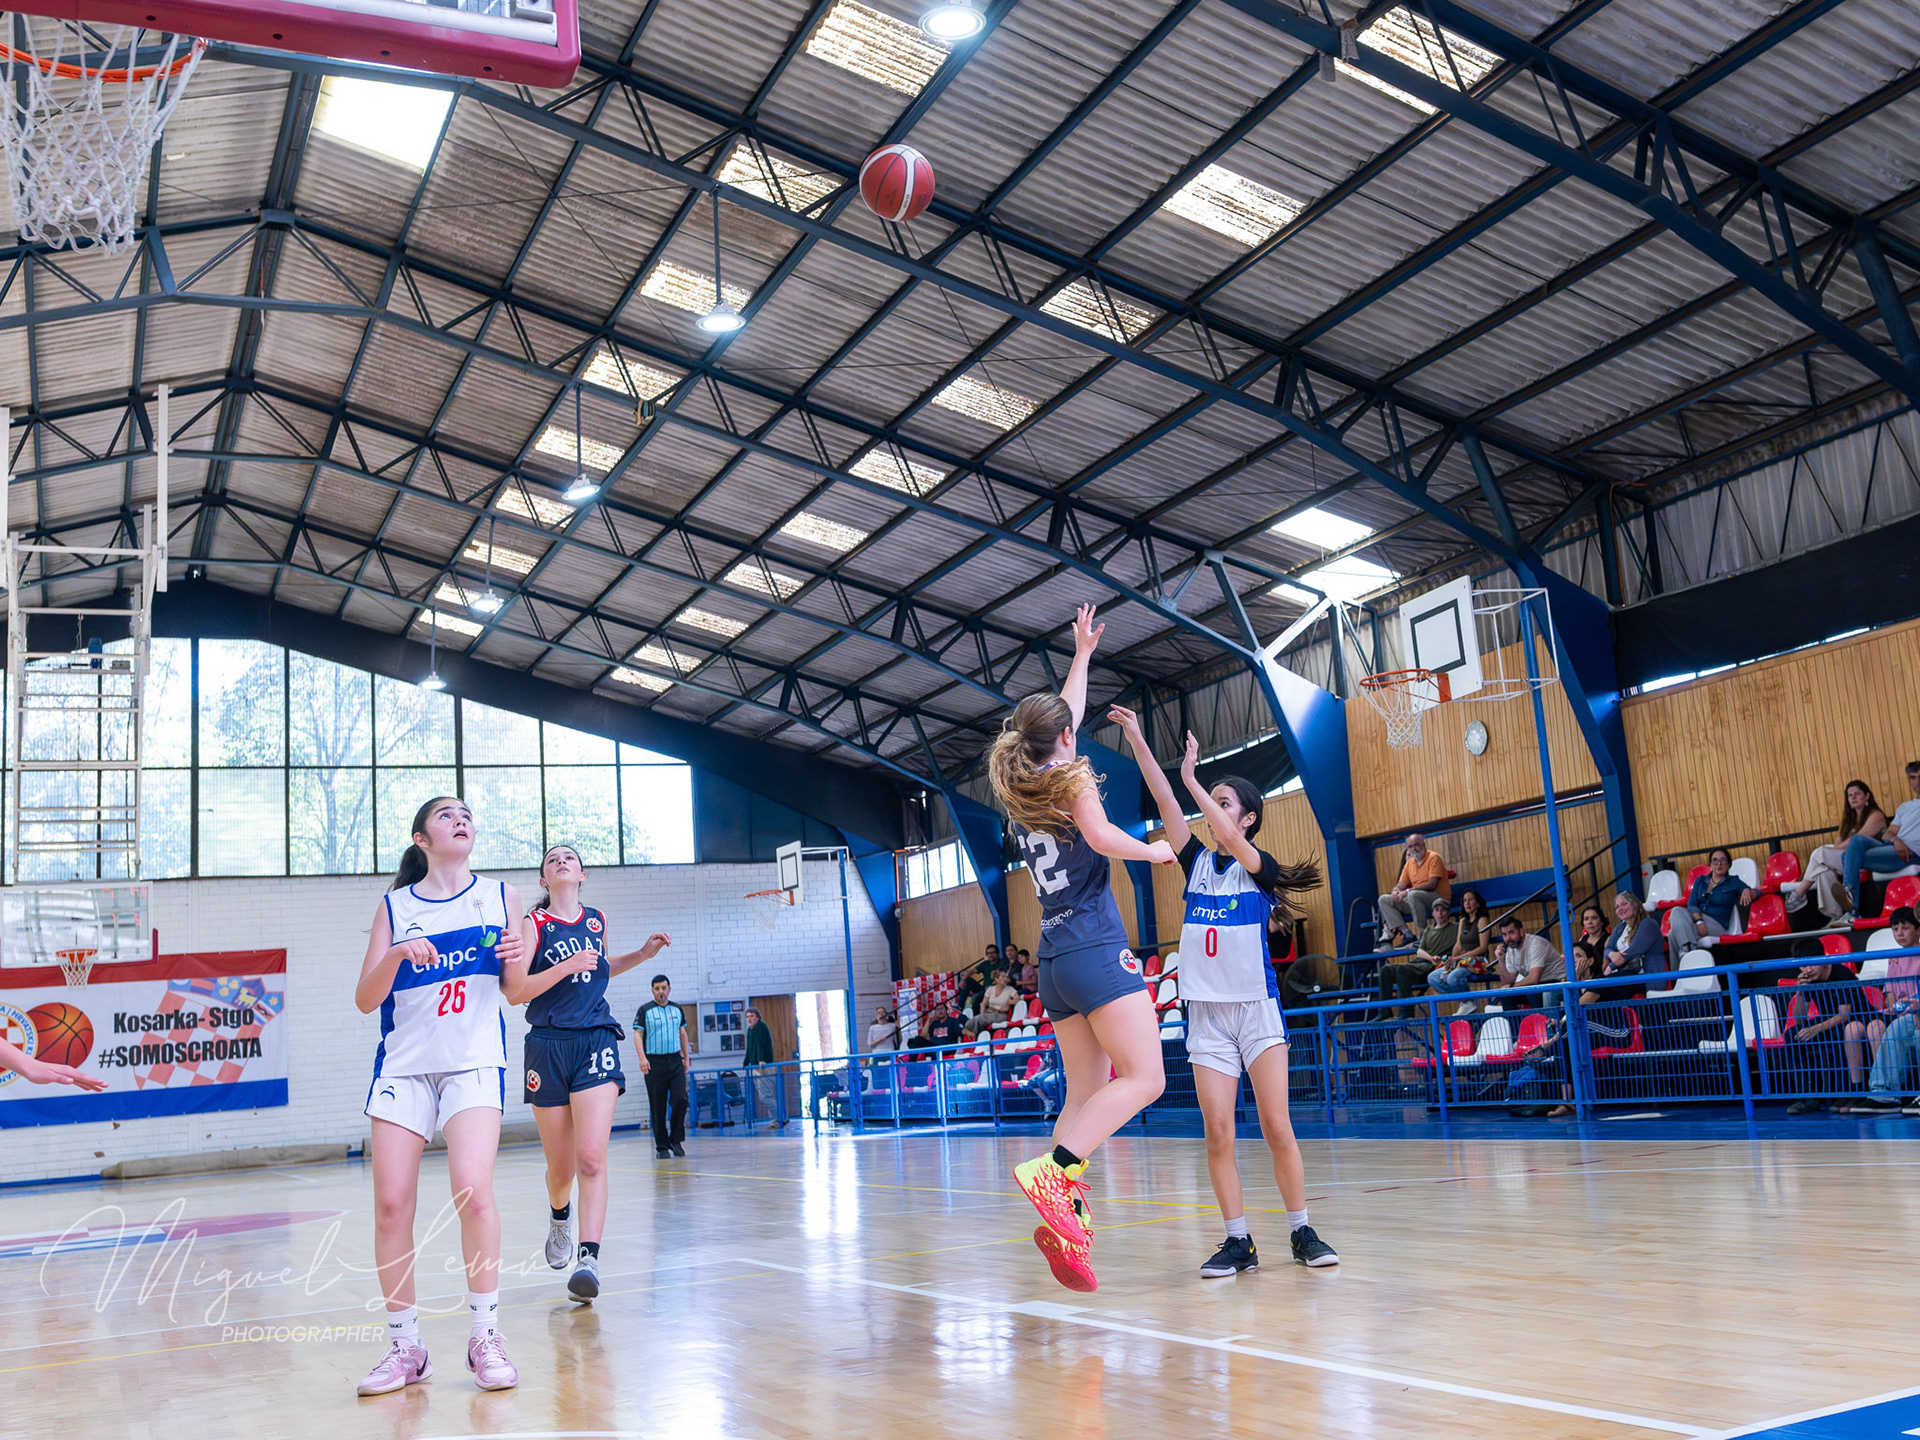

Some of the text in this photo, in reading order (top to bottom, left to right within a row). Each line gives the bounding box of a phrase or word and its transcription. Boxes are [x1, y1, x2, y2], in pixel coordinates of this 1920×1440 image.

[1192, 906, 1227, 921] cmpc
[544, 936, 604, 966] CROAT
[1205, 927, 1218, 958] 0
[437, 979, 467, 1017] 26
[209, 1006, 255, 1029] Stgo
[98, 1037, 263, 1069] #SOMOSCROATA
[588, 1046, 616, 1075] 16
